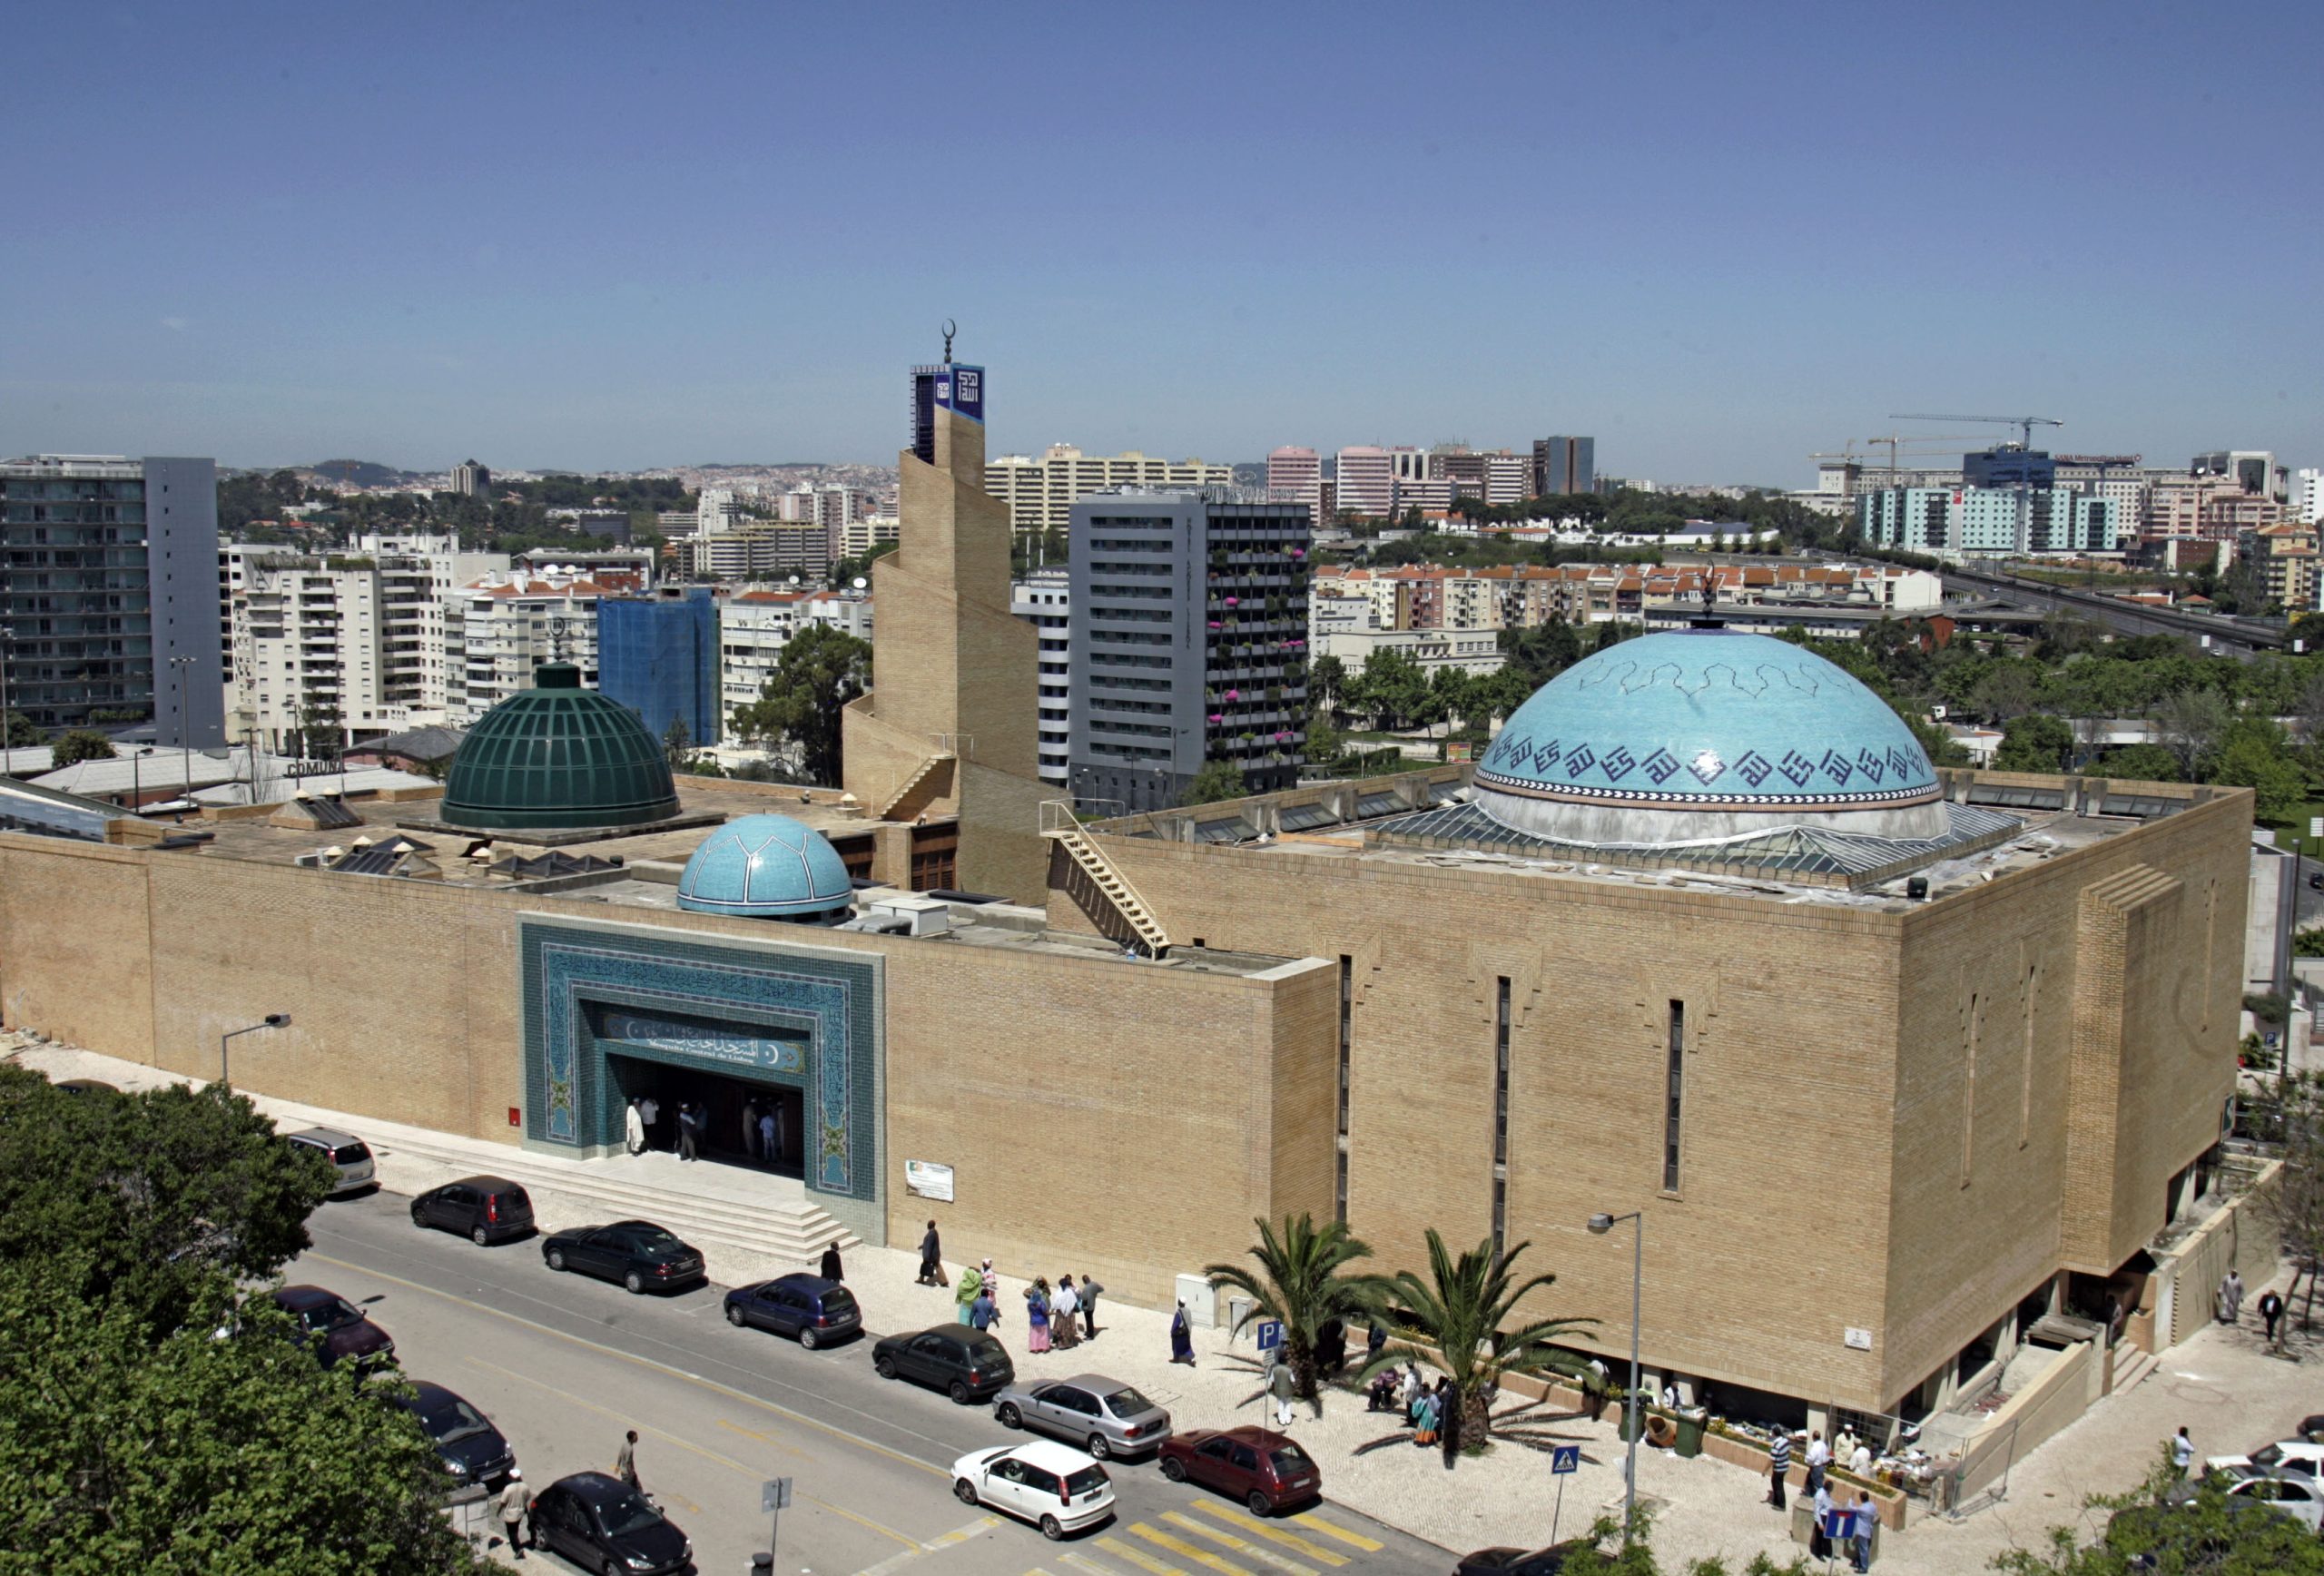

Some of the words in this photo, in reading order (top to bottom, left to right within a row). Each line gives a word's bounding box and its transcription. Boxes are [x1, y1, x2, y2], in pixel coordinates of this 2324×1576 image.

[685, 1048, 715, 1058] Central
[729, 1054, 754, 1064] Lisboa
[1264, 1324, 1275, 1346] P
